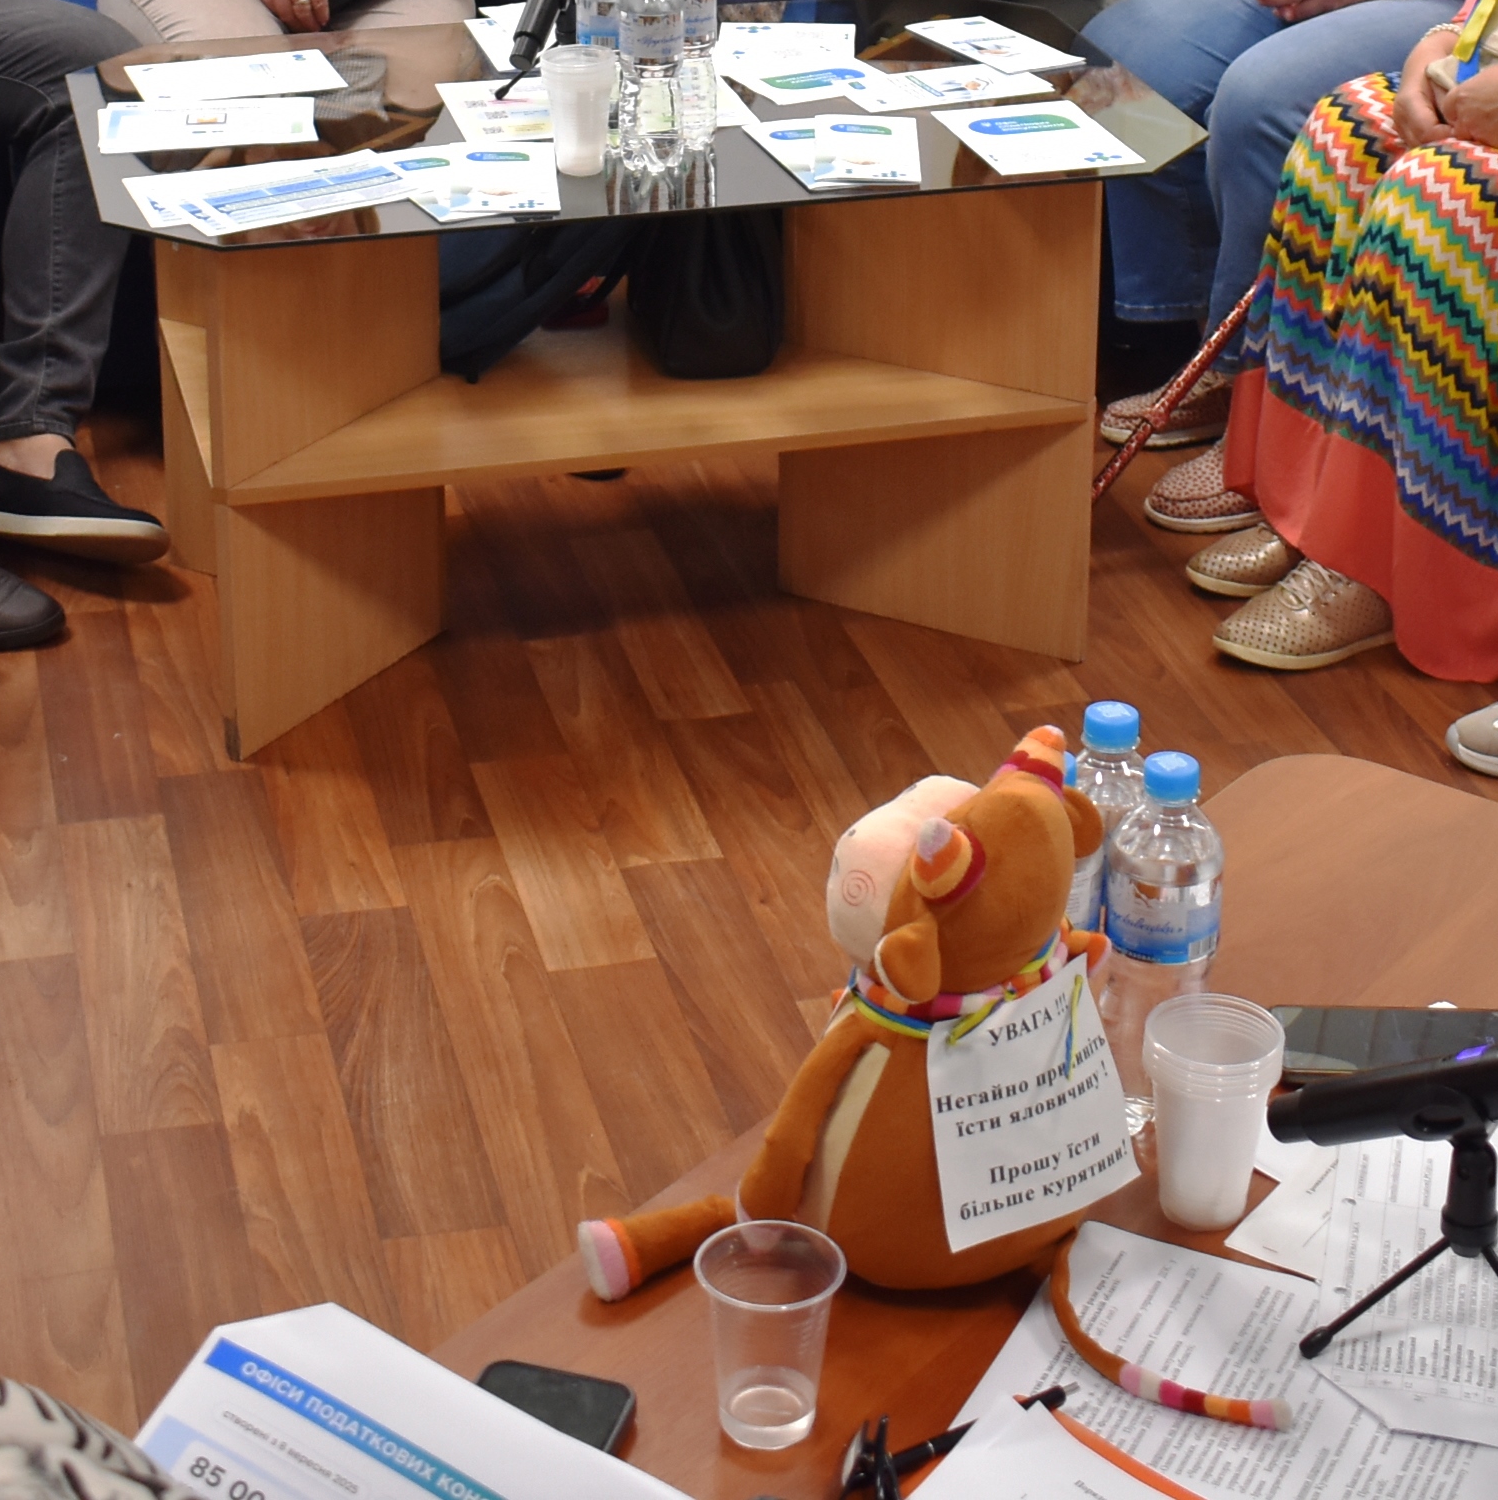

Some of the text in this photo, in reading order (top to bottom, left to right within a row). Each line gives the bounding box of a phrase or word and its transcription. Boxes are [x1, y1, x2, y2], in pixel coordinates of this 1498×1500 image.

[987, 1007, 1052, 1047] УВАГА
[936, 1033, 1106, 1114] Негайно прииніть
[956, 1116, 1002, 1138] їсти
[989, 1131, 1101, 1184] Прошу їсти
[959, 1187, 1036, 1221] більше
[241, 1360, 305, 1403] ОФІСИ
[305, 1395, 437, 1481] ПОДАТКОВИХ
[189, 1455, 227, 1488] 85
